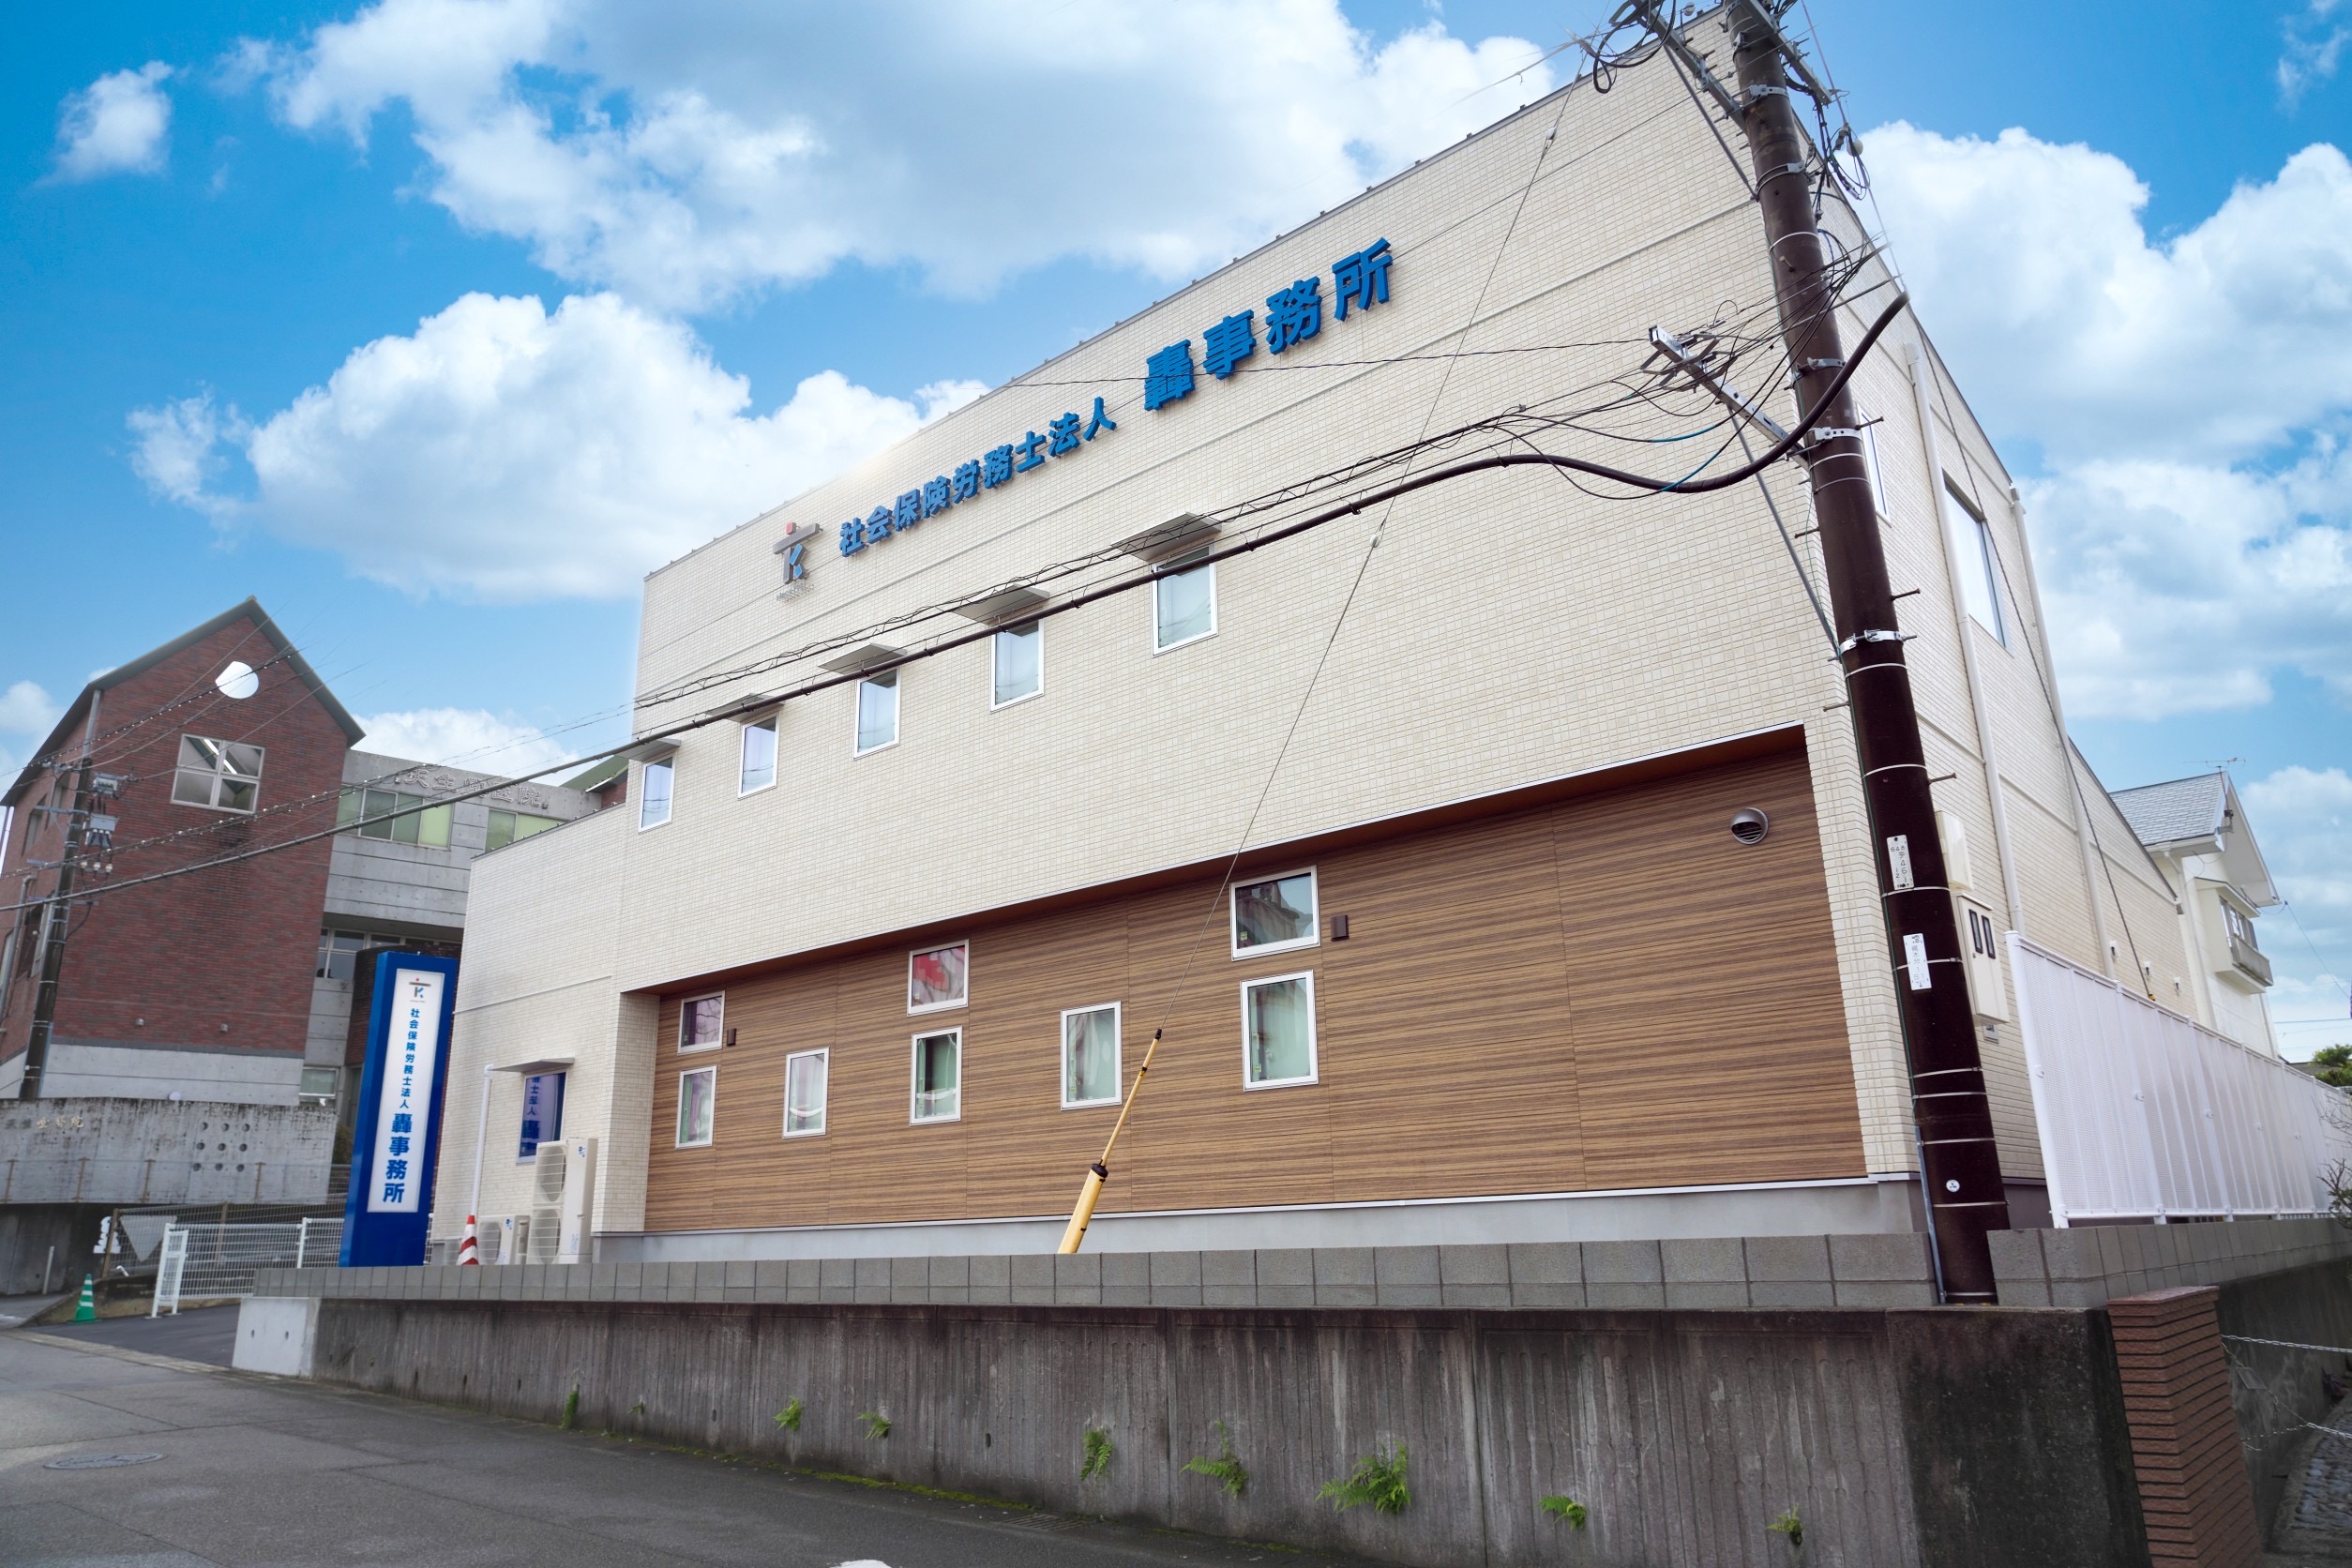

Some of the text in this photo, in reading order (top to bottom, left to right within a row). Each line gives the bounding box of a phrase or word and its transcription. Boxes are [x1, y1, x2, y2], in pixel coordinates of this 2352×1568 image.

[839, 237, 1394, 557] 社会保険労務士法人 轟事務所
[400, 1008, 420, 1108] 社会保険労務士法人
[383, 1113, 413, 1203] 轟事務所
